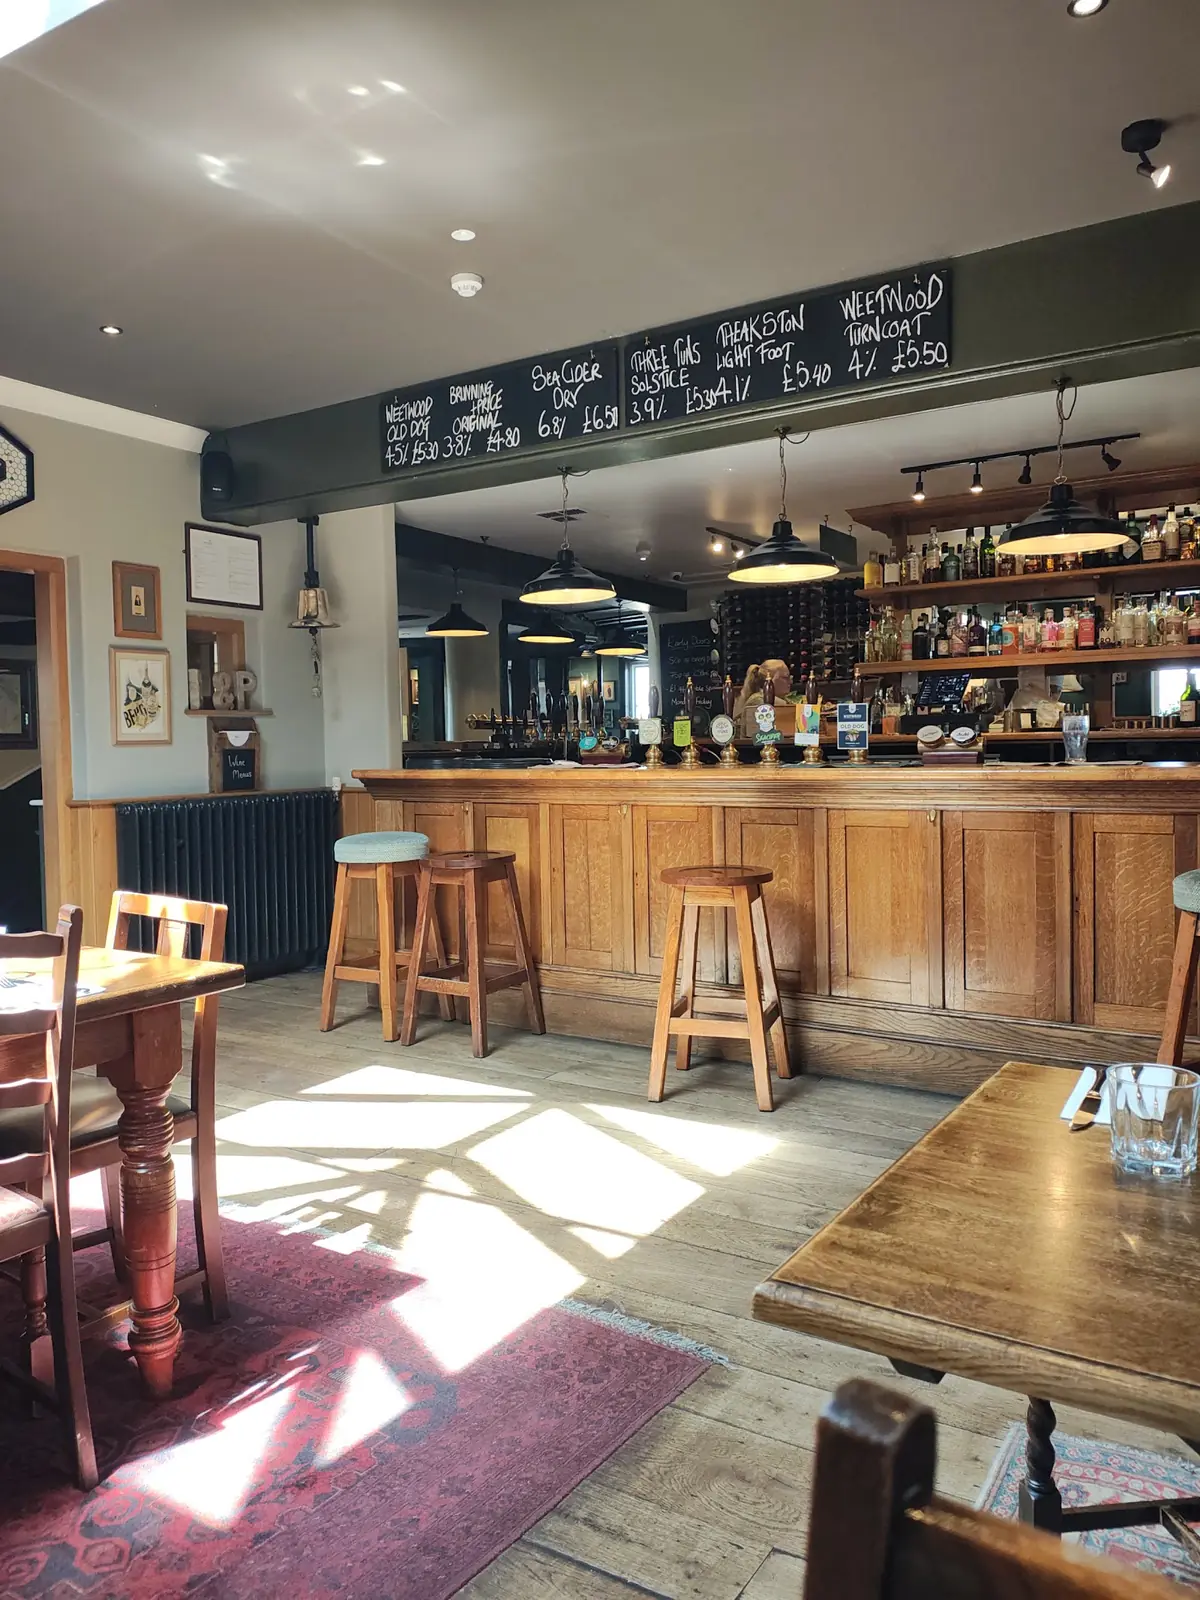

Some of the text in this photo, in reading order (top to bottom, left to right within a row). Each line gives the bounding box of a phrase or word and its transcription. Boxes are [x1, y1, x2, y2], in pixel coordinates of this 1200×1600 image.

[840, 274, 943, 320] WEETWOOD
[716, 304, 804, 348] THEAKSTON
[844, 311, 931, 346] TURNCOAT
[631, 345, 670, 373] THREE
[716, 339, 795, 371] LIGHT FOOT
[848, 340, 947, 379] 4% £5.50
[532, 359, 603, 391] SEA CIDER
[631, 369, 690, 395] SOLSTICE
[715, 361, 831, 404] 4.1% £5.40
[449, 380, 494, 404] BRUNNING
[553, 383, 584, 409] DRY
[630, 386, 717, 424] 3.9% £5.30
[386, 396, 433, 423] WEETWOOD
[452, 410, 503, 435] ORIGINAL
[538, 405, 618, 439] 6.8% £6.50
[387, 416, 431, 442] OLD DOG
[442, 427, 520, 457] 3.8% £4.80
[385, 440, 438, 467] 4.5% £5.30
[228, 755, 246, 767] Wine
[232, 769, 252, 781] Menus
